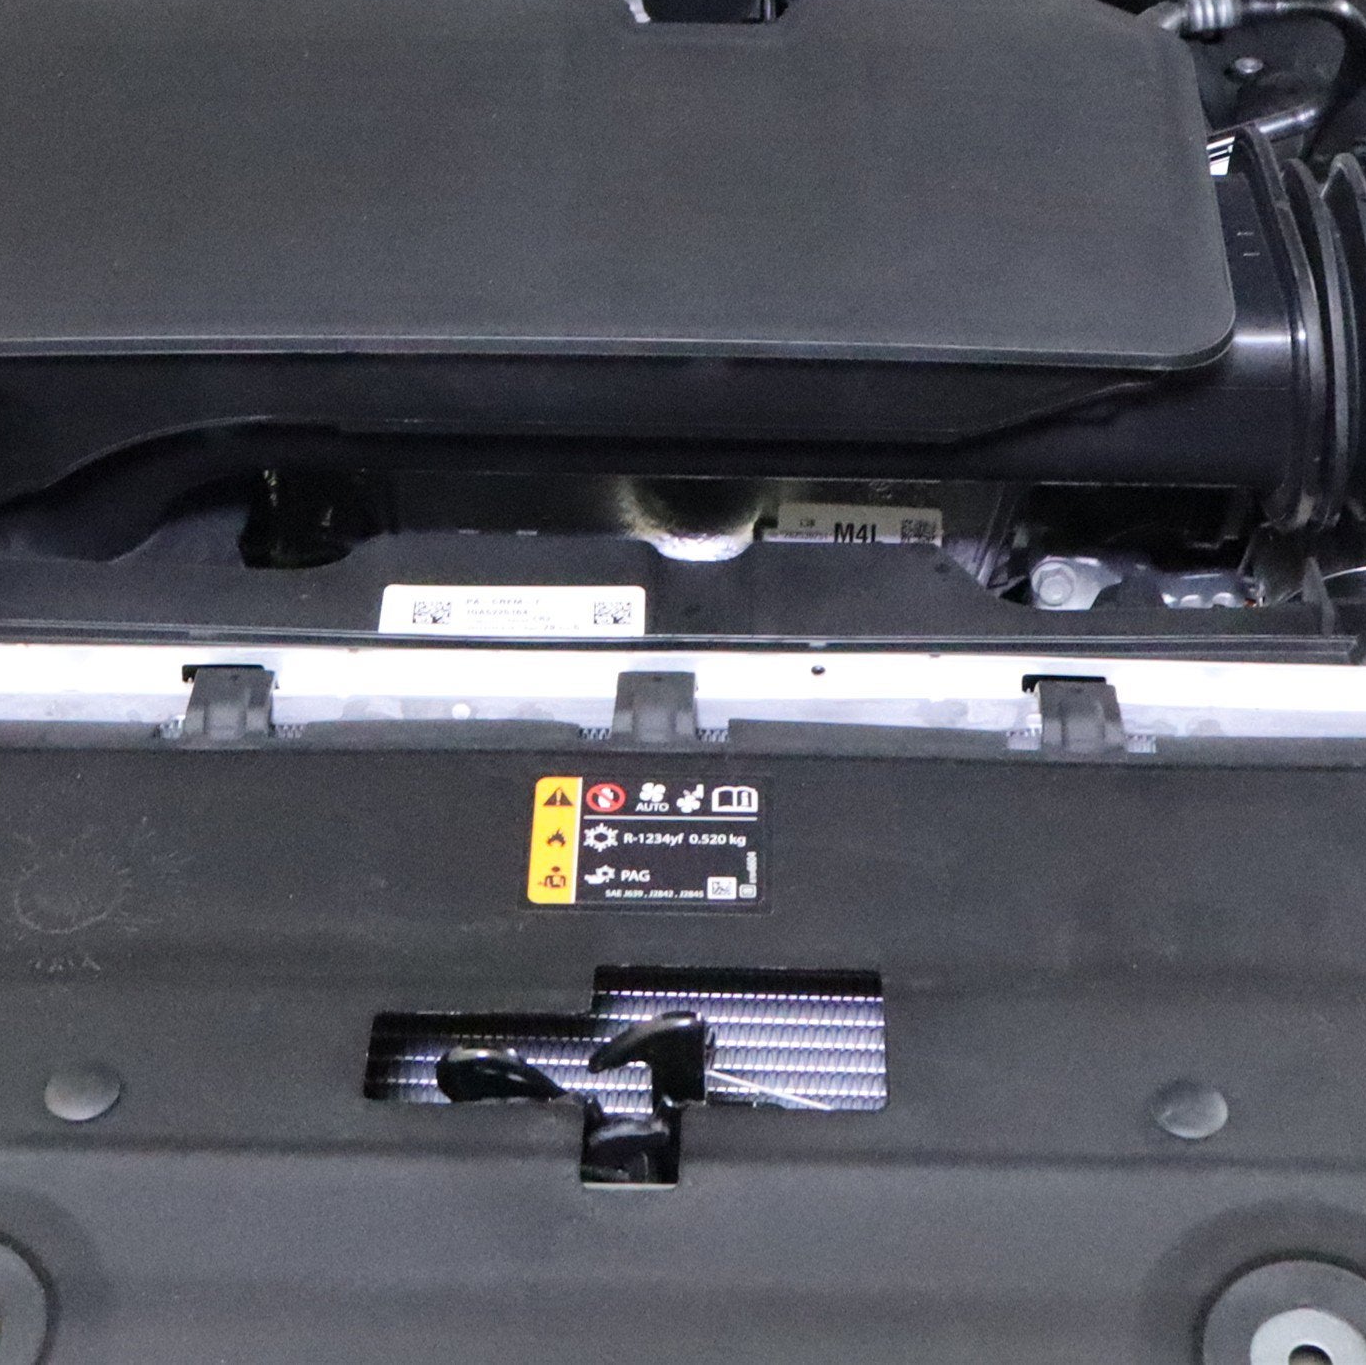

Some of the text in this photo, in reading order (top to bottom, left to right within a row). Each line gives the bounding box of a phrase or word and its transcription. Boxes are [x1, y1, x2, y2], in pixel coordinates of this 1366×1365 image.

[635, 802, 670, 812] AUTO
[623, 832, 747, 847] R-1234yf 0.520 kg
[620, 869, 651, 883] PAG
